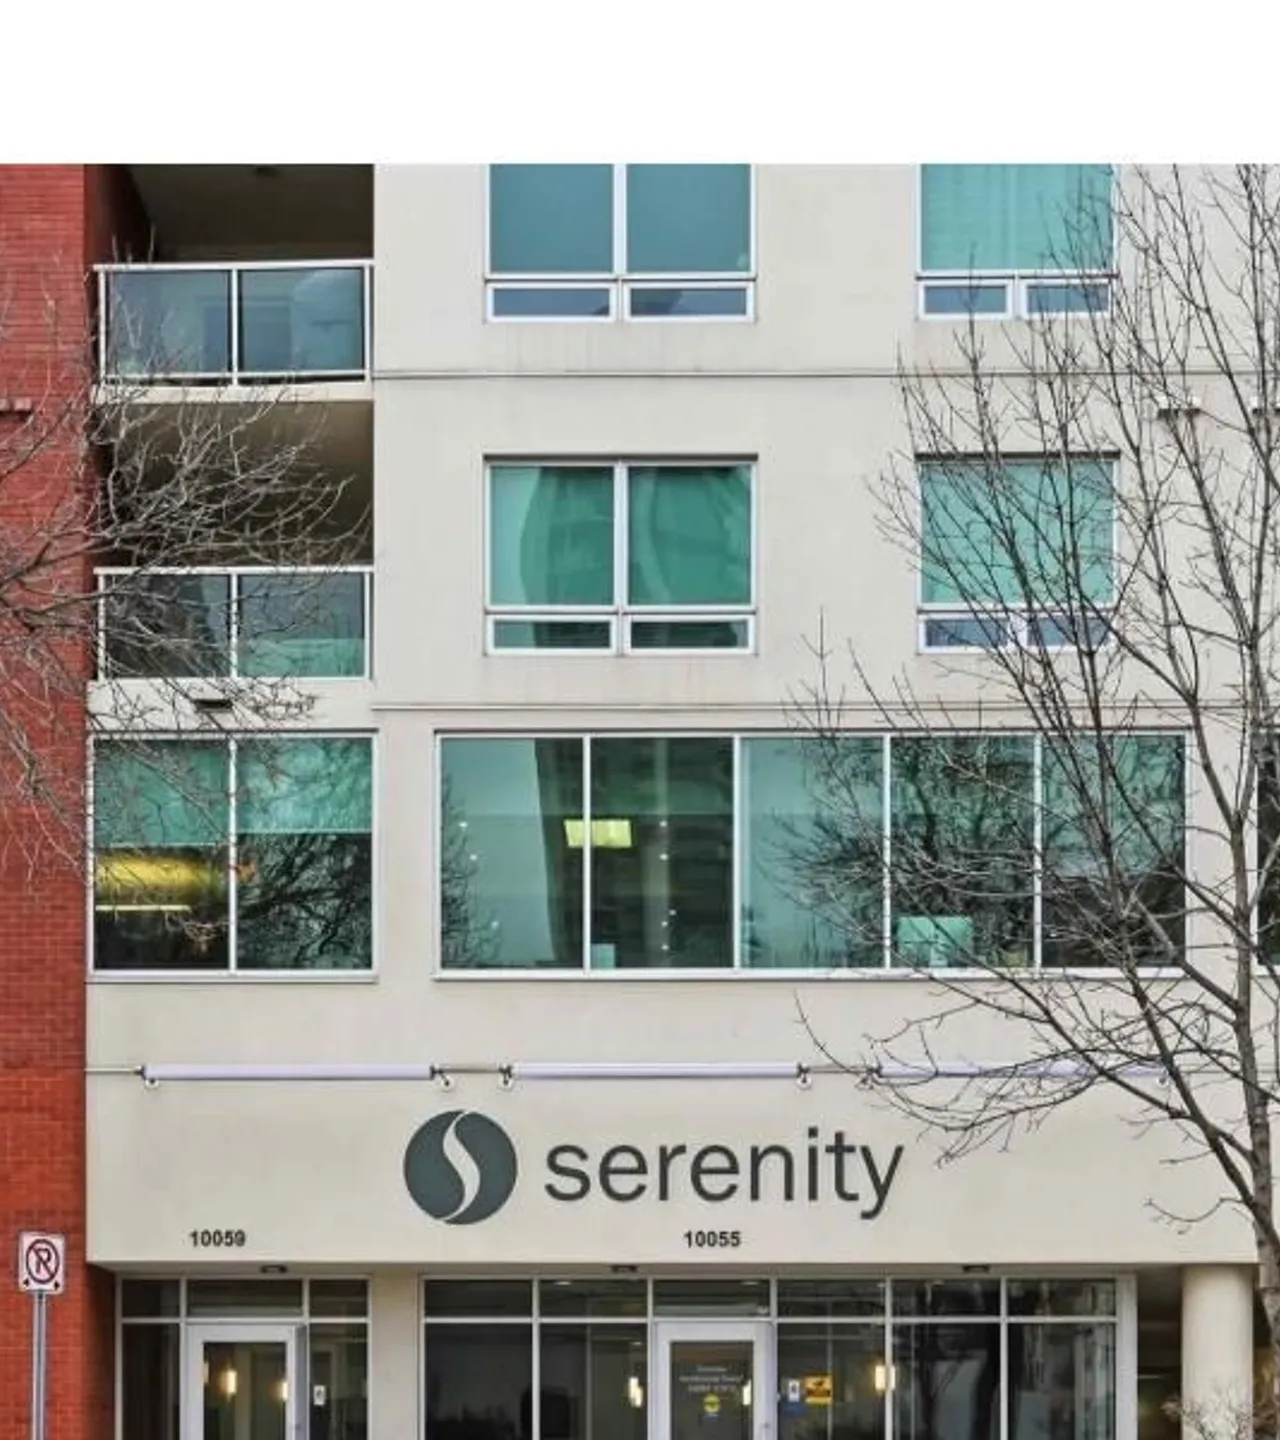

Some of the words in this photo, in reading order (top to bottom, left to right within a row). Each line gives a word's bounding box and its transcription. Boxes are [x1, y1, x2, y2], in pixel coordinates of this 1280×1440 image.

[545, 1127, 905, 1221] serenity
[189, 1231, 246, 1247] 10059
[684, 1231, 741, 1247] 10055
